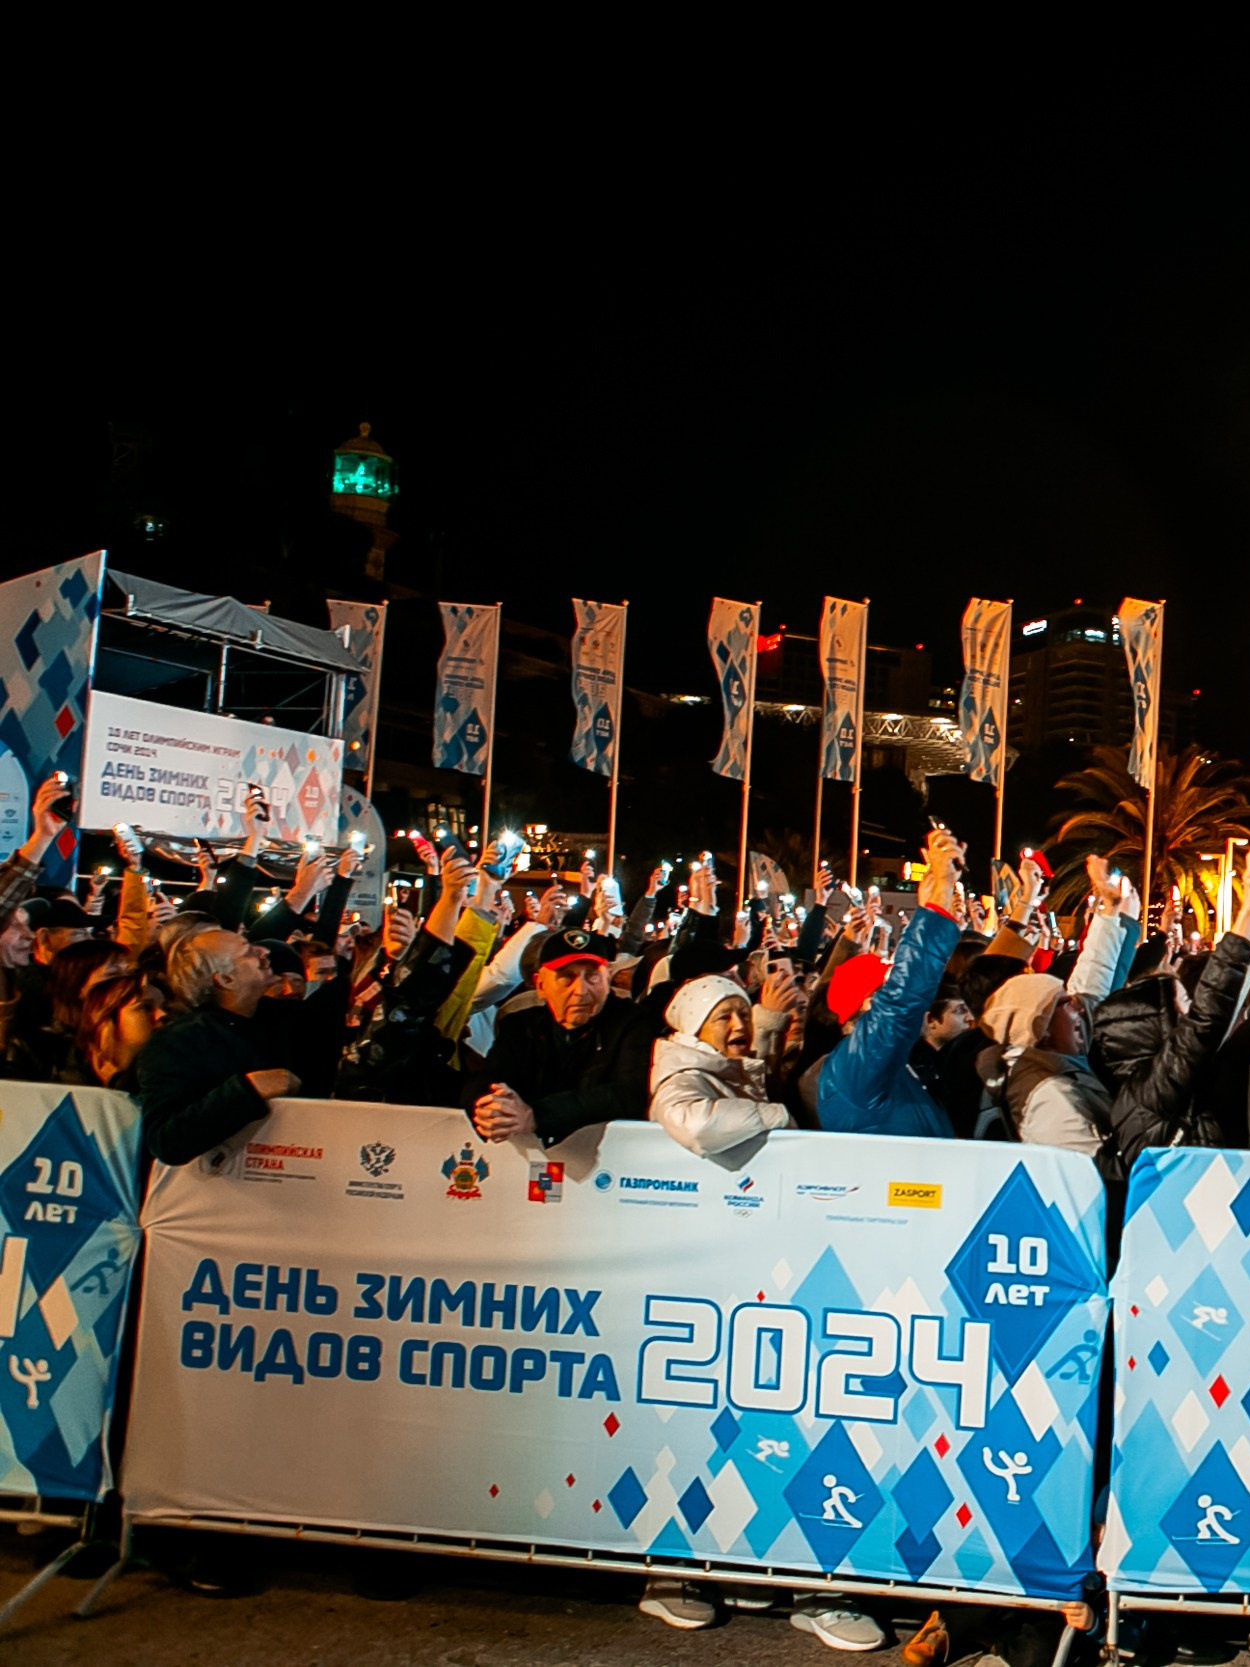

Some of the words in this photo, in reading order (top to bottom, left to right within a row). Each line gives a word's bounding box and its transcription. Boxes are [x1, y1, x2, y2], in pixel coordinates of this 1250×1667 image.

[100, 781, 156, 804] ВИДОВ
[159, 789, 212, 810] СПОРТА
[101, 761, 145, 780] ДЕНЬ
[149, 767, 209, 790] ЗИМНИХ
[25, 1157, 83, 1198] 10
[619, 1177, 699, 1193] ГАЗПРОМБАНК
[893, 1188, 937, 1198] ZASPORT
[986, 1233, 1049, 1277] 10
[181, 1258, 339, 1316] ДЕНЬ
[352, 1272, 603, 1338] ЗИМНИХ
[179, 1319, 384, 1385] ВИДОВ
[398, 1337, 621, 1402] СПОРТА
[636, 1294, 992, 1432] 2024
